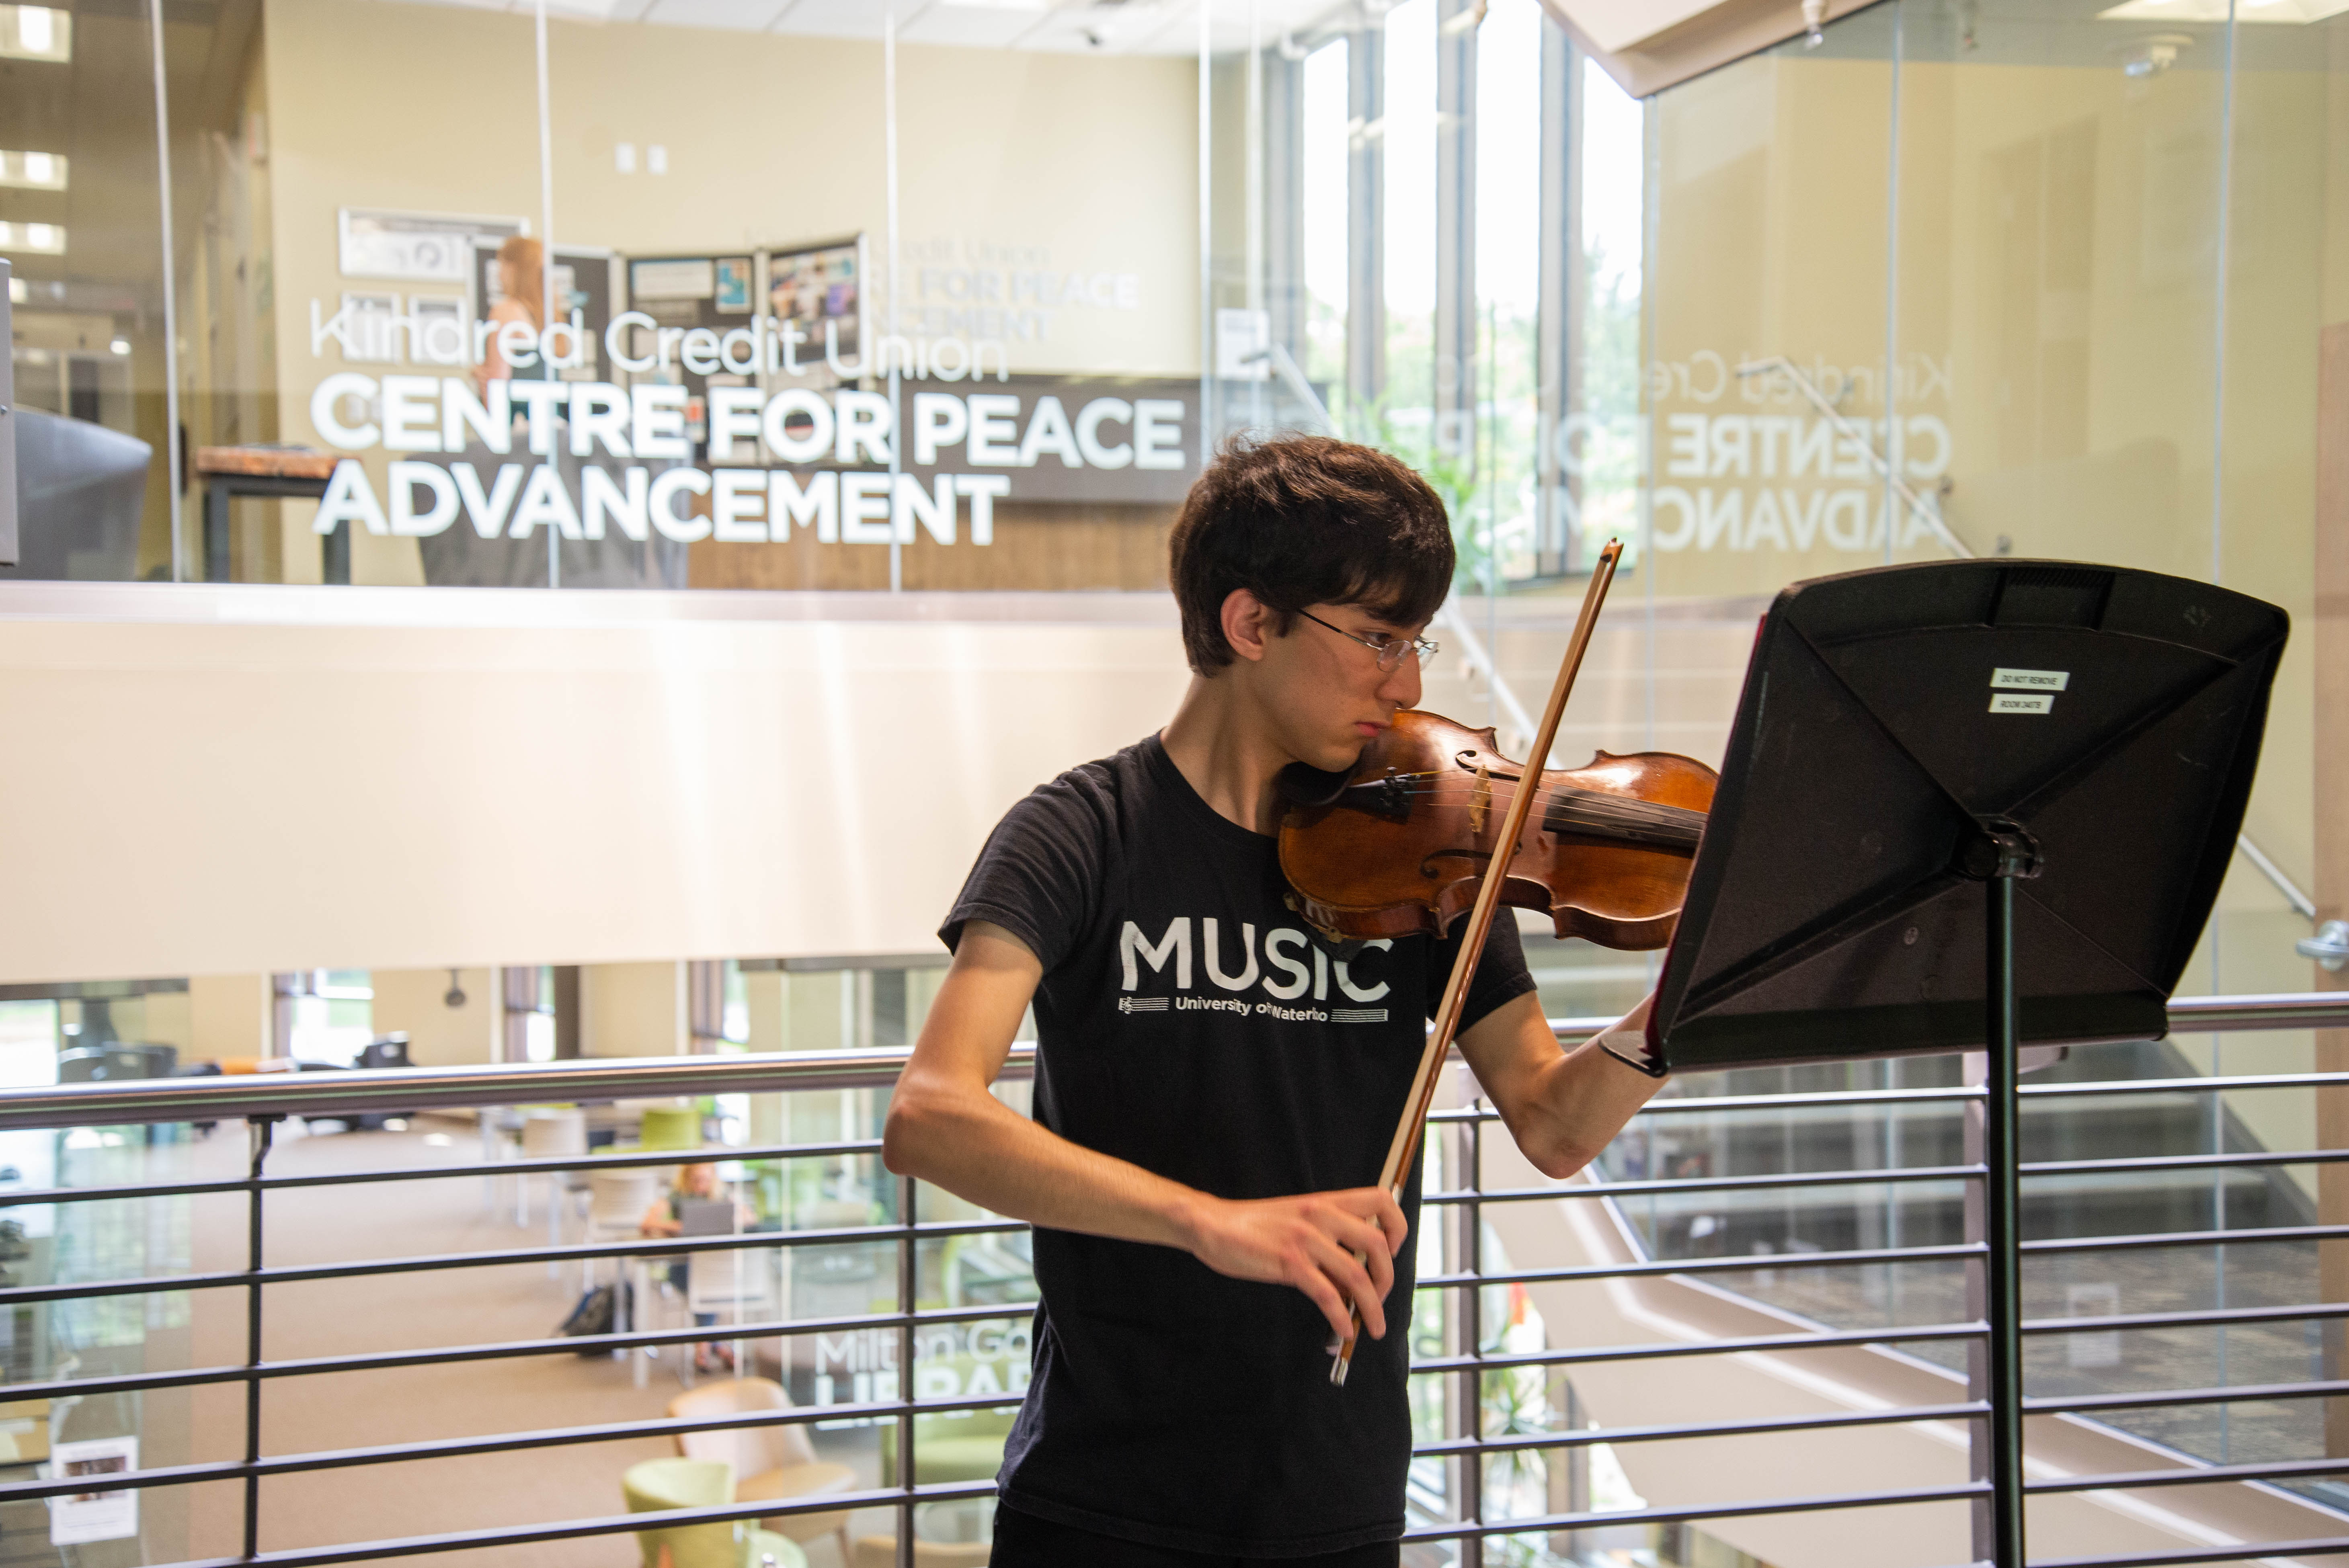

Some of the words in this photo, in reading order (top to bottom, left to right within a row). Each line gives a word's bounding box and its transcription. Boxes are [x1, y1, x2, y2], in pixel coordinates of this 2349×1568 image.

[310, 297, 584, 369] Kindred
[604, 311, 807, 378] Credit
[825, 320, 1009, 383] Union
[310, 372, 689, 459] CENTRE
[709, 385, 893, 464] FOR
[913, 392, 1186, 471] PEACE
[312, 459, 1010, 545] ADVANCEMENT
[1119, 916, 1394, 1002] MUSIC
[1176, 996, 1251, 1016] University
